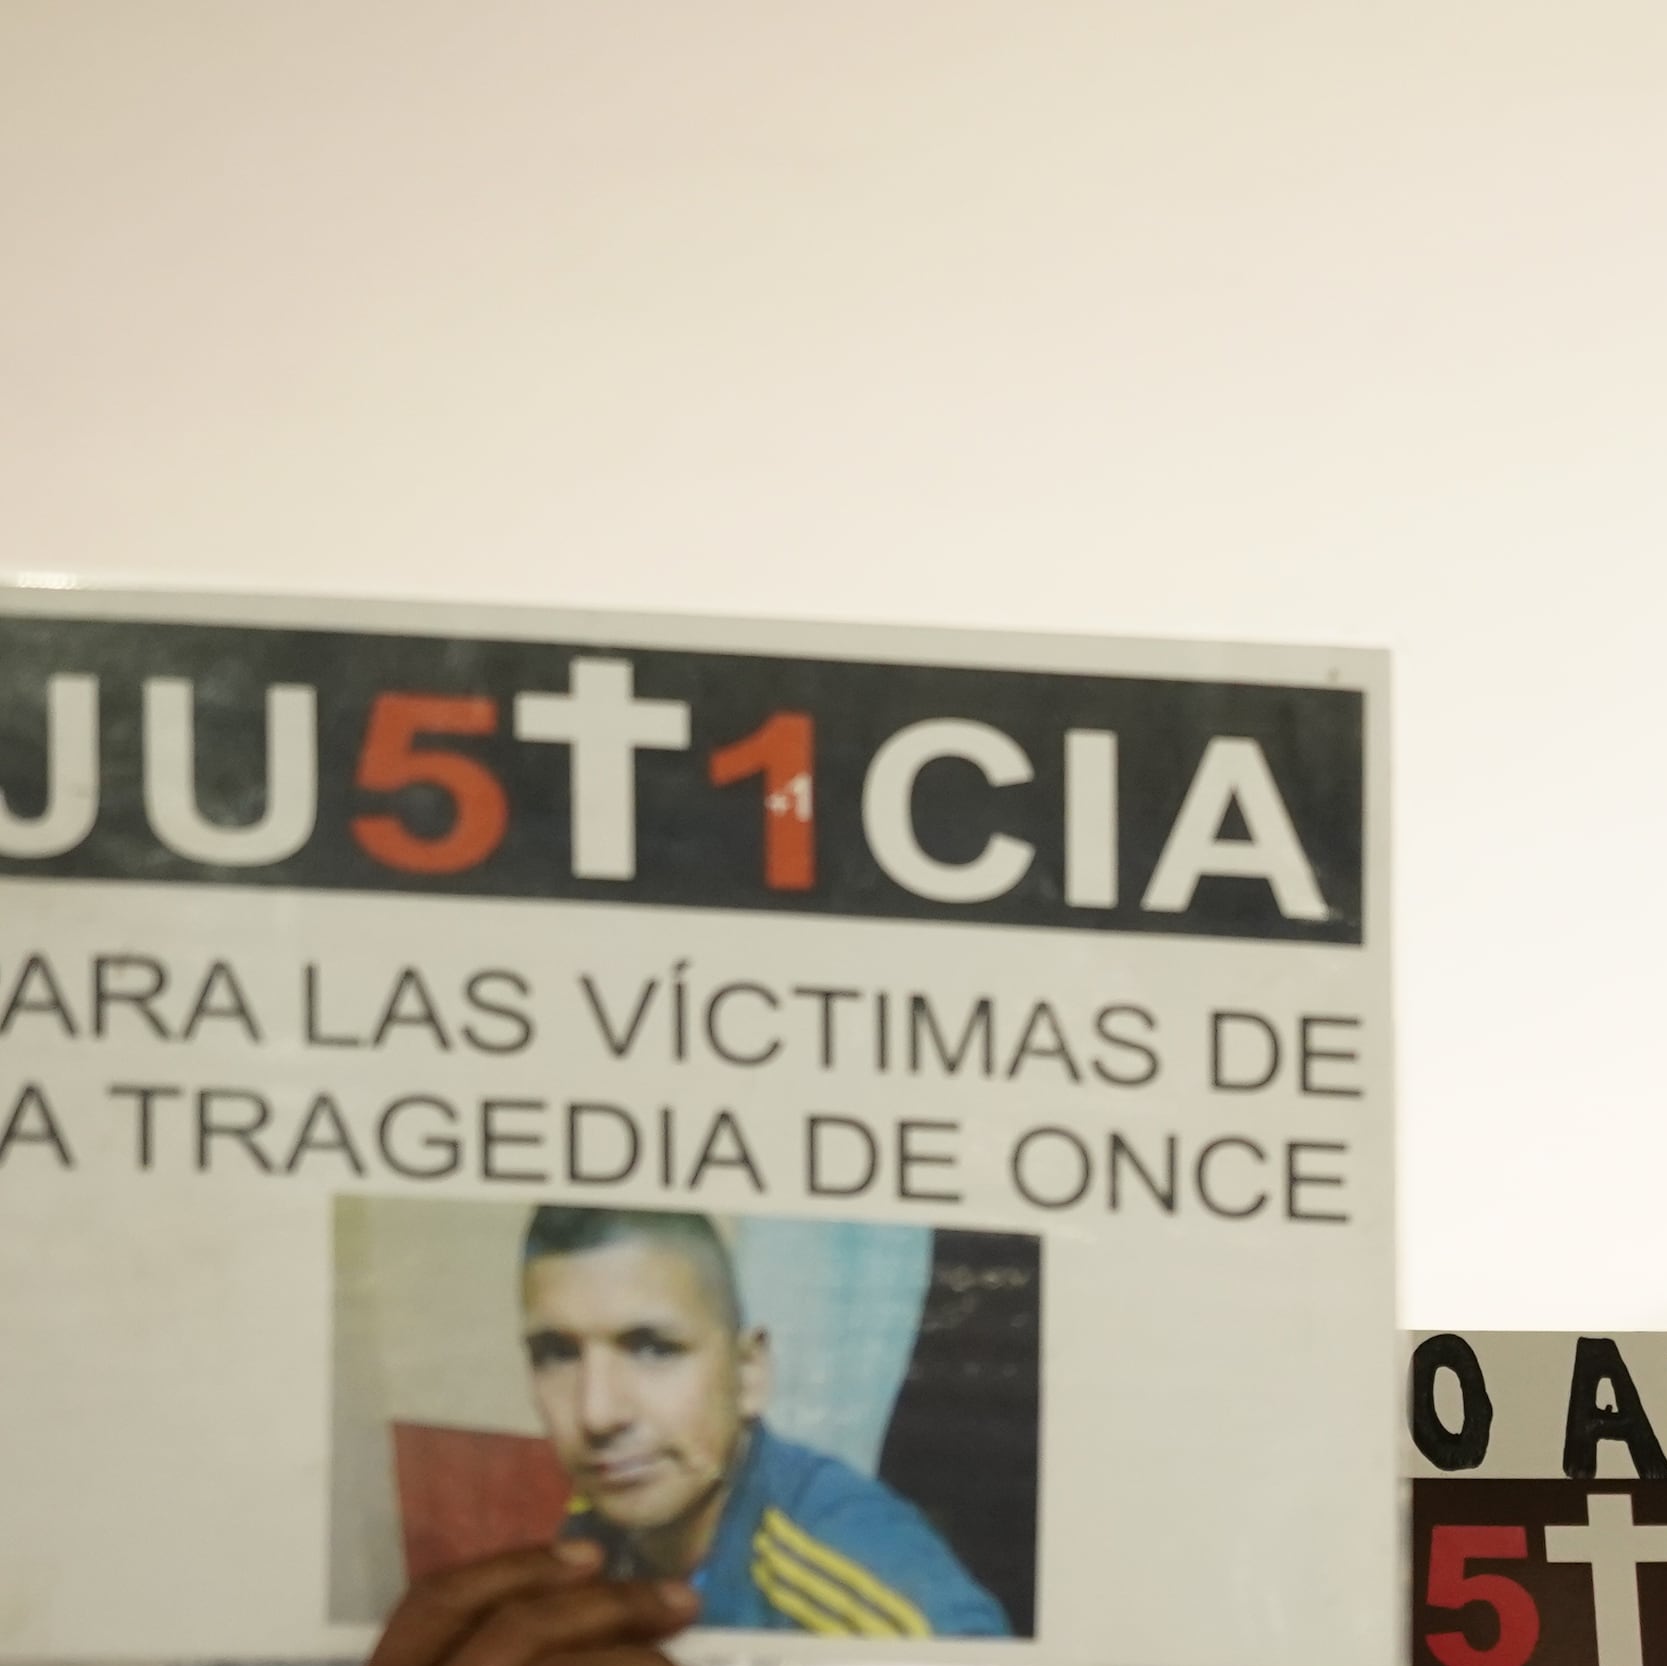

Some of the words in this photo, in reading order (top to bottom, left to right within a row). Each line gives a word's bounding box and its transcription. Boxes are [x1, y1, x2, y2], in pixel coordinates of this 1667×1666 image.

[302, 961, 536, 1055] LAS
[578, 959, 1161, 1088] VÍCTIMAS
[1212, 1011, 1363, 1097] DE
[107, 1086, 765, 1193] TRAGEDIA
[805, 1115, 962, 1204] DE
[1011, 1127, 1350, 1224] ONCE
